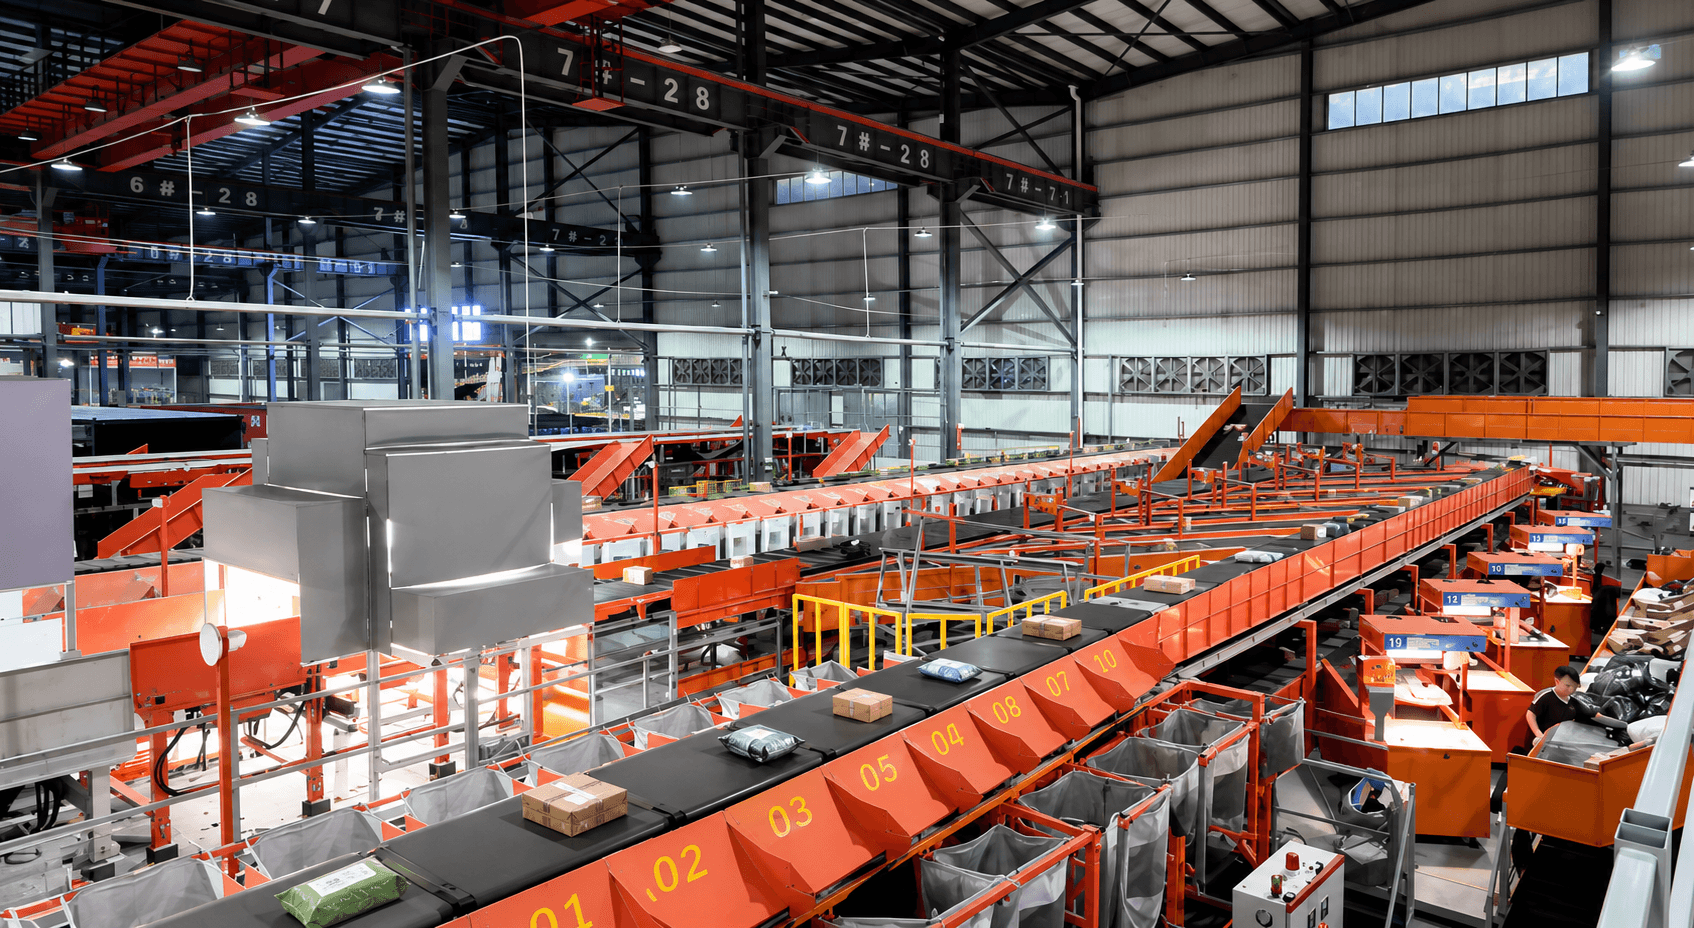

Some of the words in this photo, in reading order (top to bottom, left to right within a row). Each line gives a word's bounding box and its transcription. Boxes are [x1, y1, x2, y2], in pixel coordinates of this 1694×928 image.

[1491, 565, 1502, 573] 10
[1446, 595, 1458, 604] 12
[1389, 637, 1402, 648] 19
[1094, 649, 1117, 673] 10
[1046, 671, 1070, 697] 07
[992, 696, 1021, 724] 08
[931, 723, 964, 755] 04
[860, 754, 898, 791] 05
[768, 796, 813, 838] 03
[653, 844, 708, 892] 02
